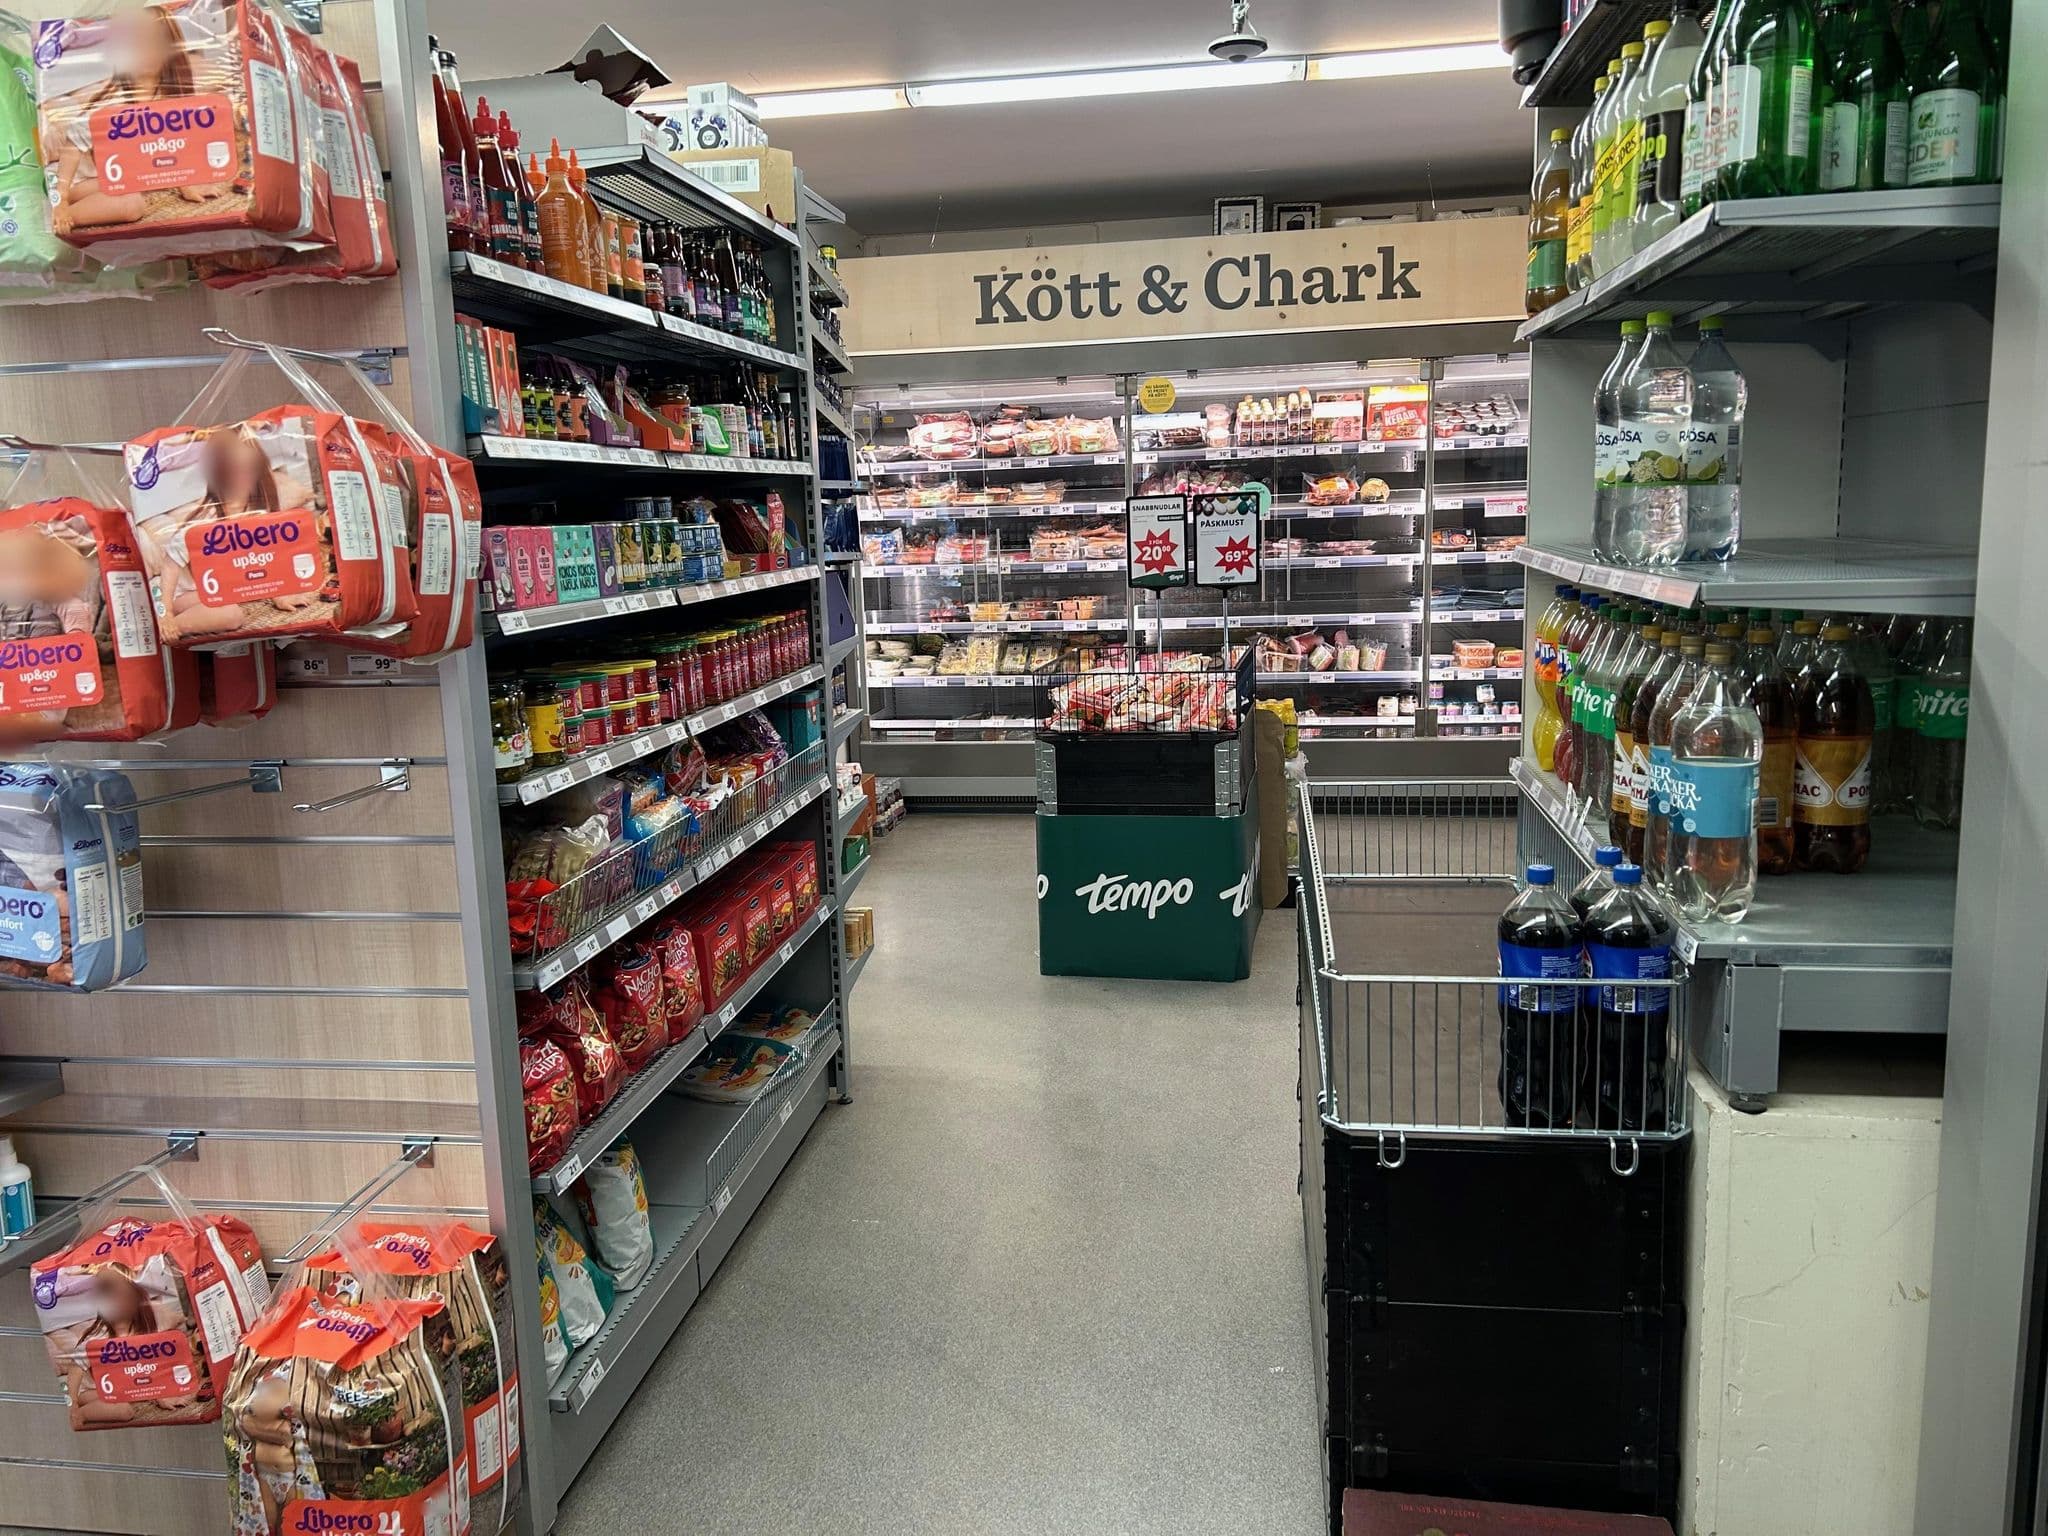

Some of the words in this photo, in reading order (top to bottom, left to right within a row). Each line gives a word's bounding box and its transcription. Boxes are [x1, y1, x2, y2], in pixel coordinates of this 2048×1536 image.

[108, 107, 215, 140] Libero
[140, 138, 185, 155] up&go
[105, 154, 122, 182] 6
[973, 267, 1122, 324] Kött
[1137, 264, 1188, 315] &
[1204, 245, 1421, 310] Chark
[1132, 503, 1181, 512] SNABBNUDLAR
[1200, 518, 1245, 528] PÅSKMUST
[203, 521, 298, 556] Libero
[232, 551, 274, 569] up&go
[1142, 546, 1162, 561] 20
[1225, 551, 1242, 562] 69
[202, 568, 219, 594] 6
[19, 668, 57, 684] up&go
[1075, 873, 1194, 919] tempo
[625, 963, 660, 997] NACHO
[530, 1052, 564, 1079] CHIPS
[316, 1317, 381, 1343] Libero
[100, 1340, 177, 1364] Libero
[124, 1363, 158, 1376] up&go
[101, 1373, 114, 1394] 6
[296, 1507, 373, 1533] Libero
[378, 1511, 404, 1535] 4
